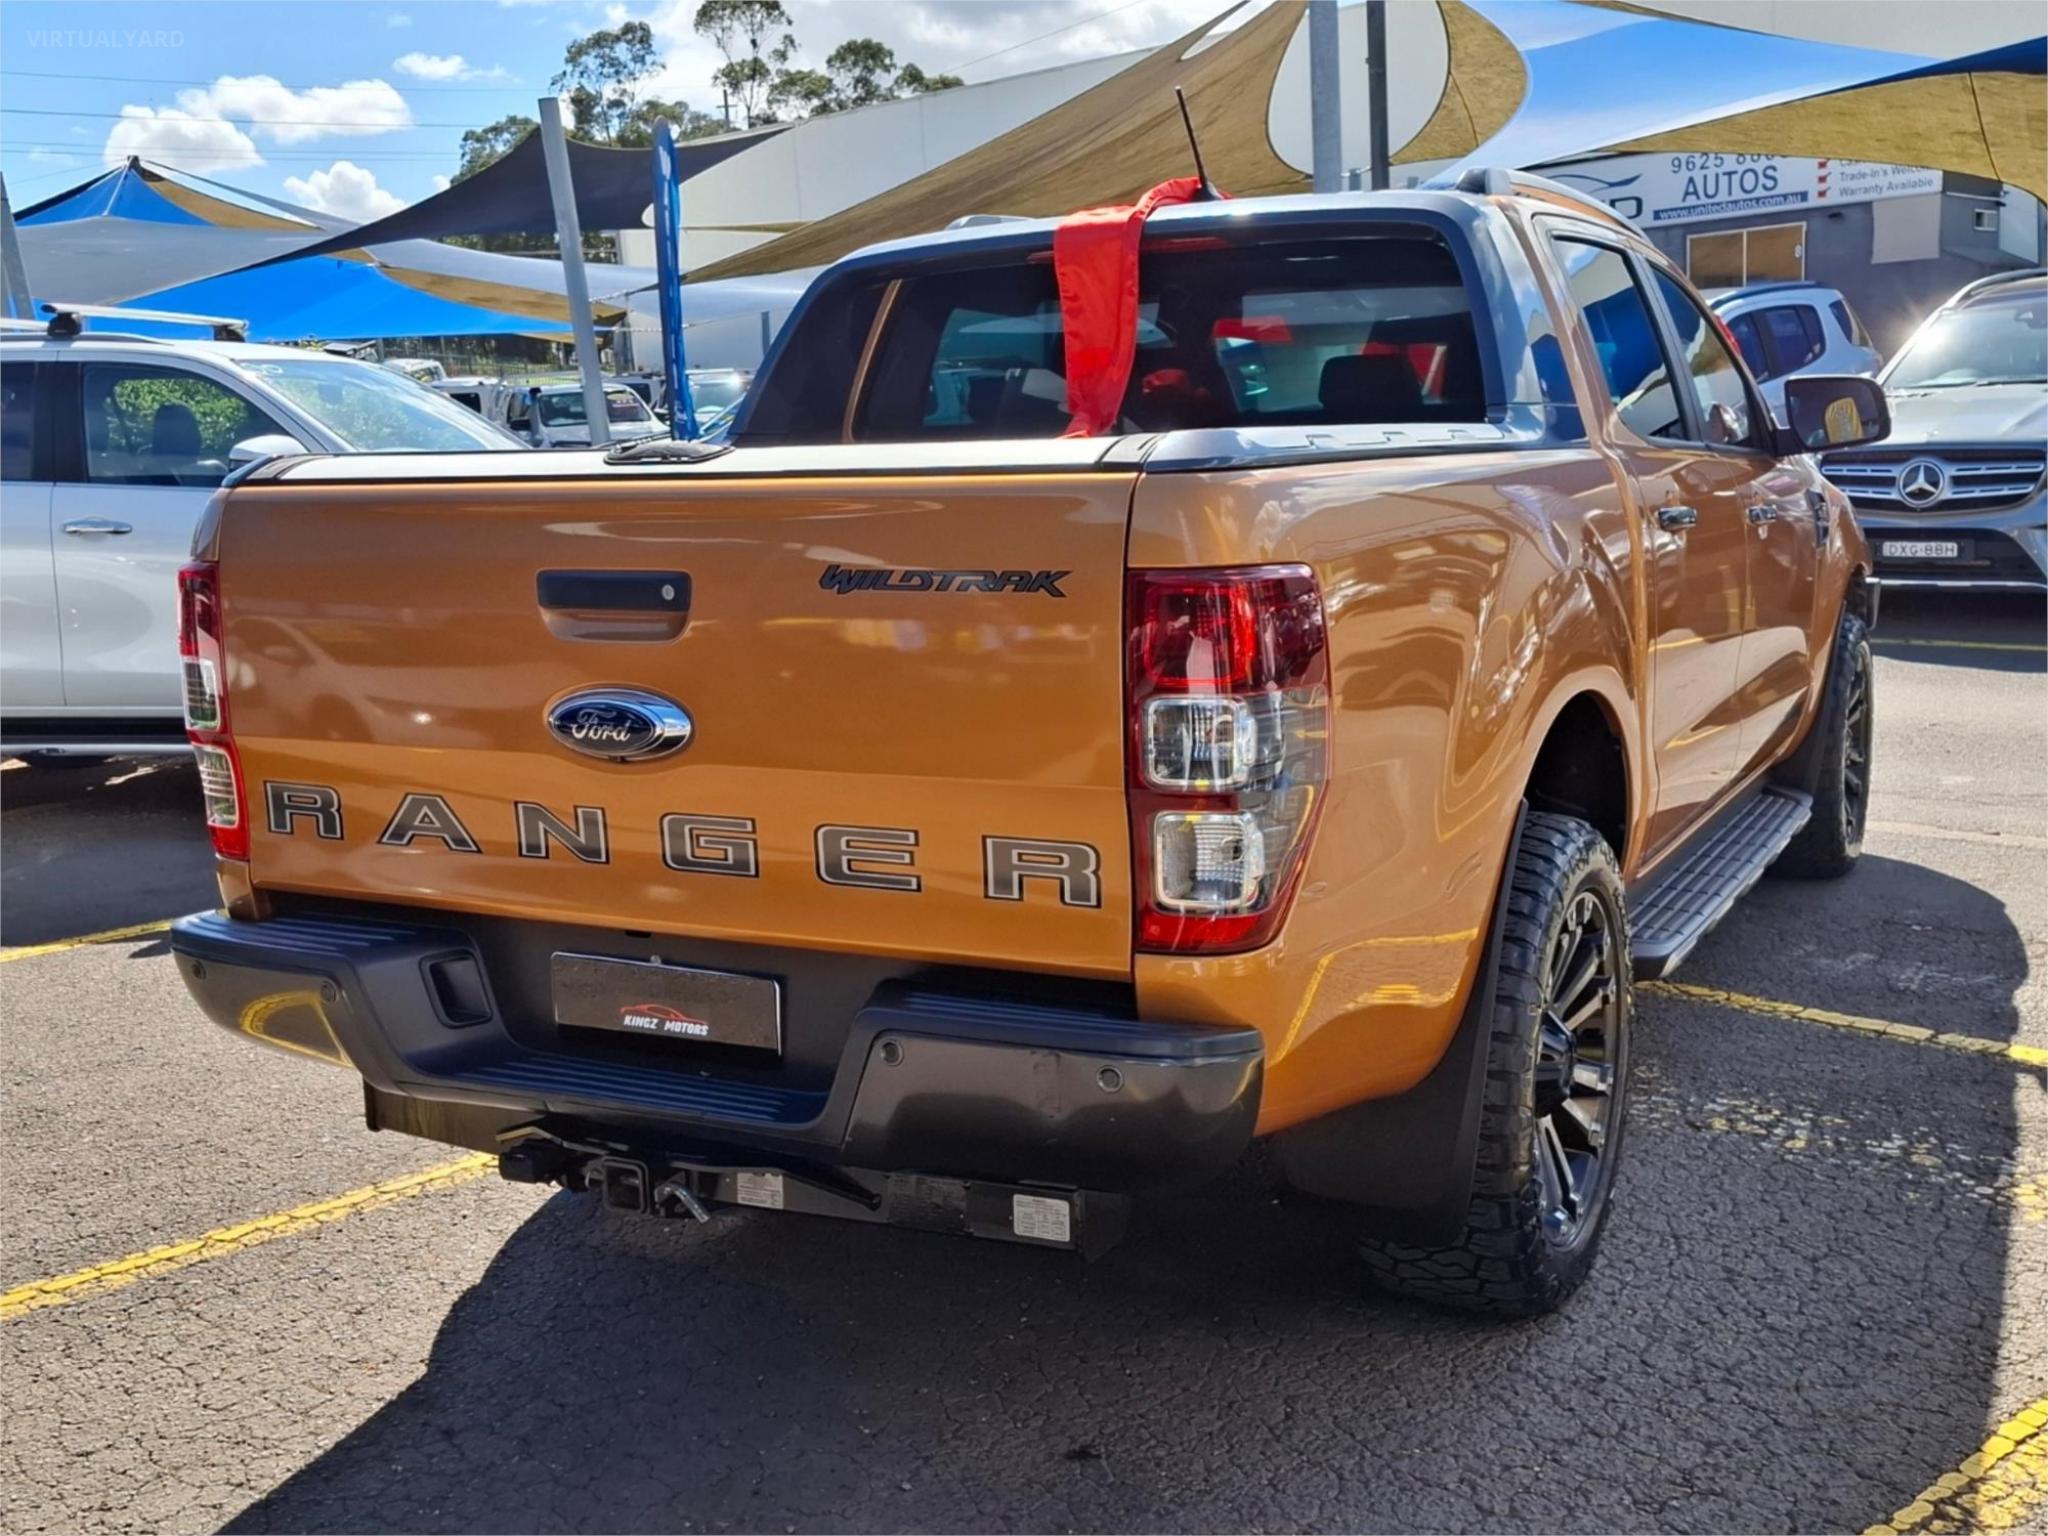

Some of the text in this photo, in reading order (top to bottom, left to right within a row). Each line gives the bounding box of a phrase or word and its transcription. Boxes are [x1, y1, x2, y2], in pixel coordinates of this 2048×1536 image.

[1671, 152, 1725, 174] 9625
[1682, 165, 1778, 203] AUTOS
[1839, 177, 1934, 197] Warranty Available
[1659, 193, 1801, 220] www.unitedautos.com.au
[819, 564, 1073, 598] WILDTRAK
[571, 708, 632, 742] Ford
[263, 780, 1103, 909] RANGER
[624, 1014, 709, 1036] KINGZ MOTORS
